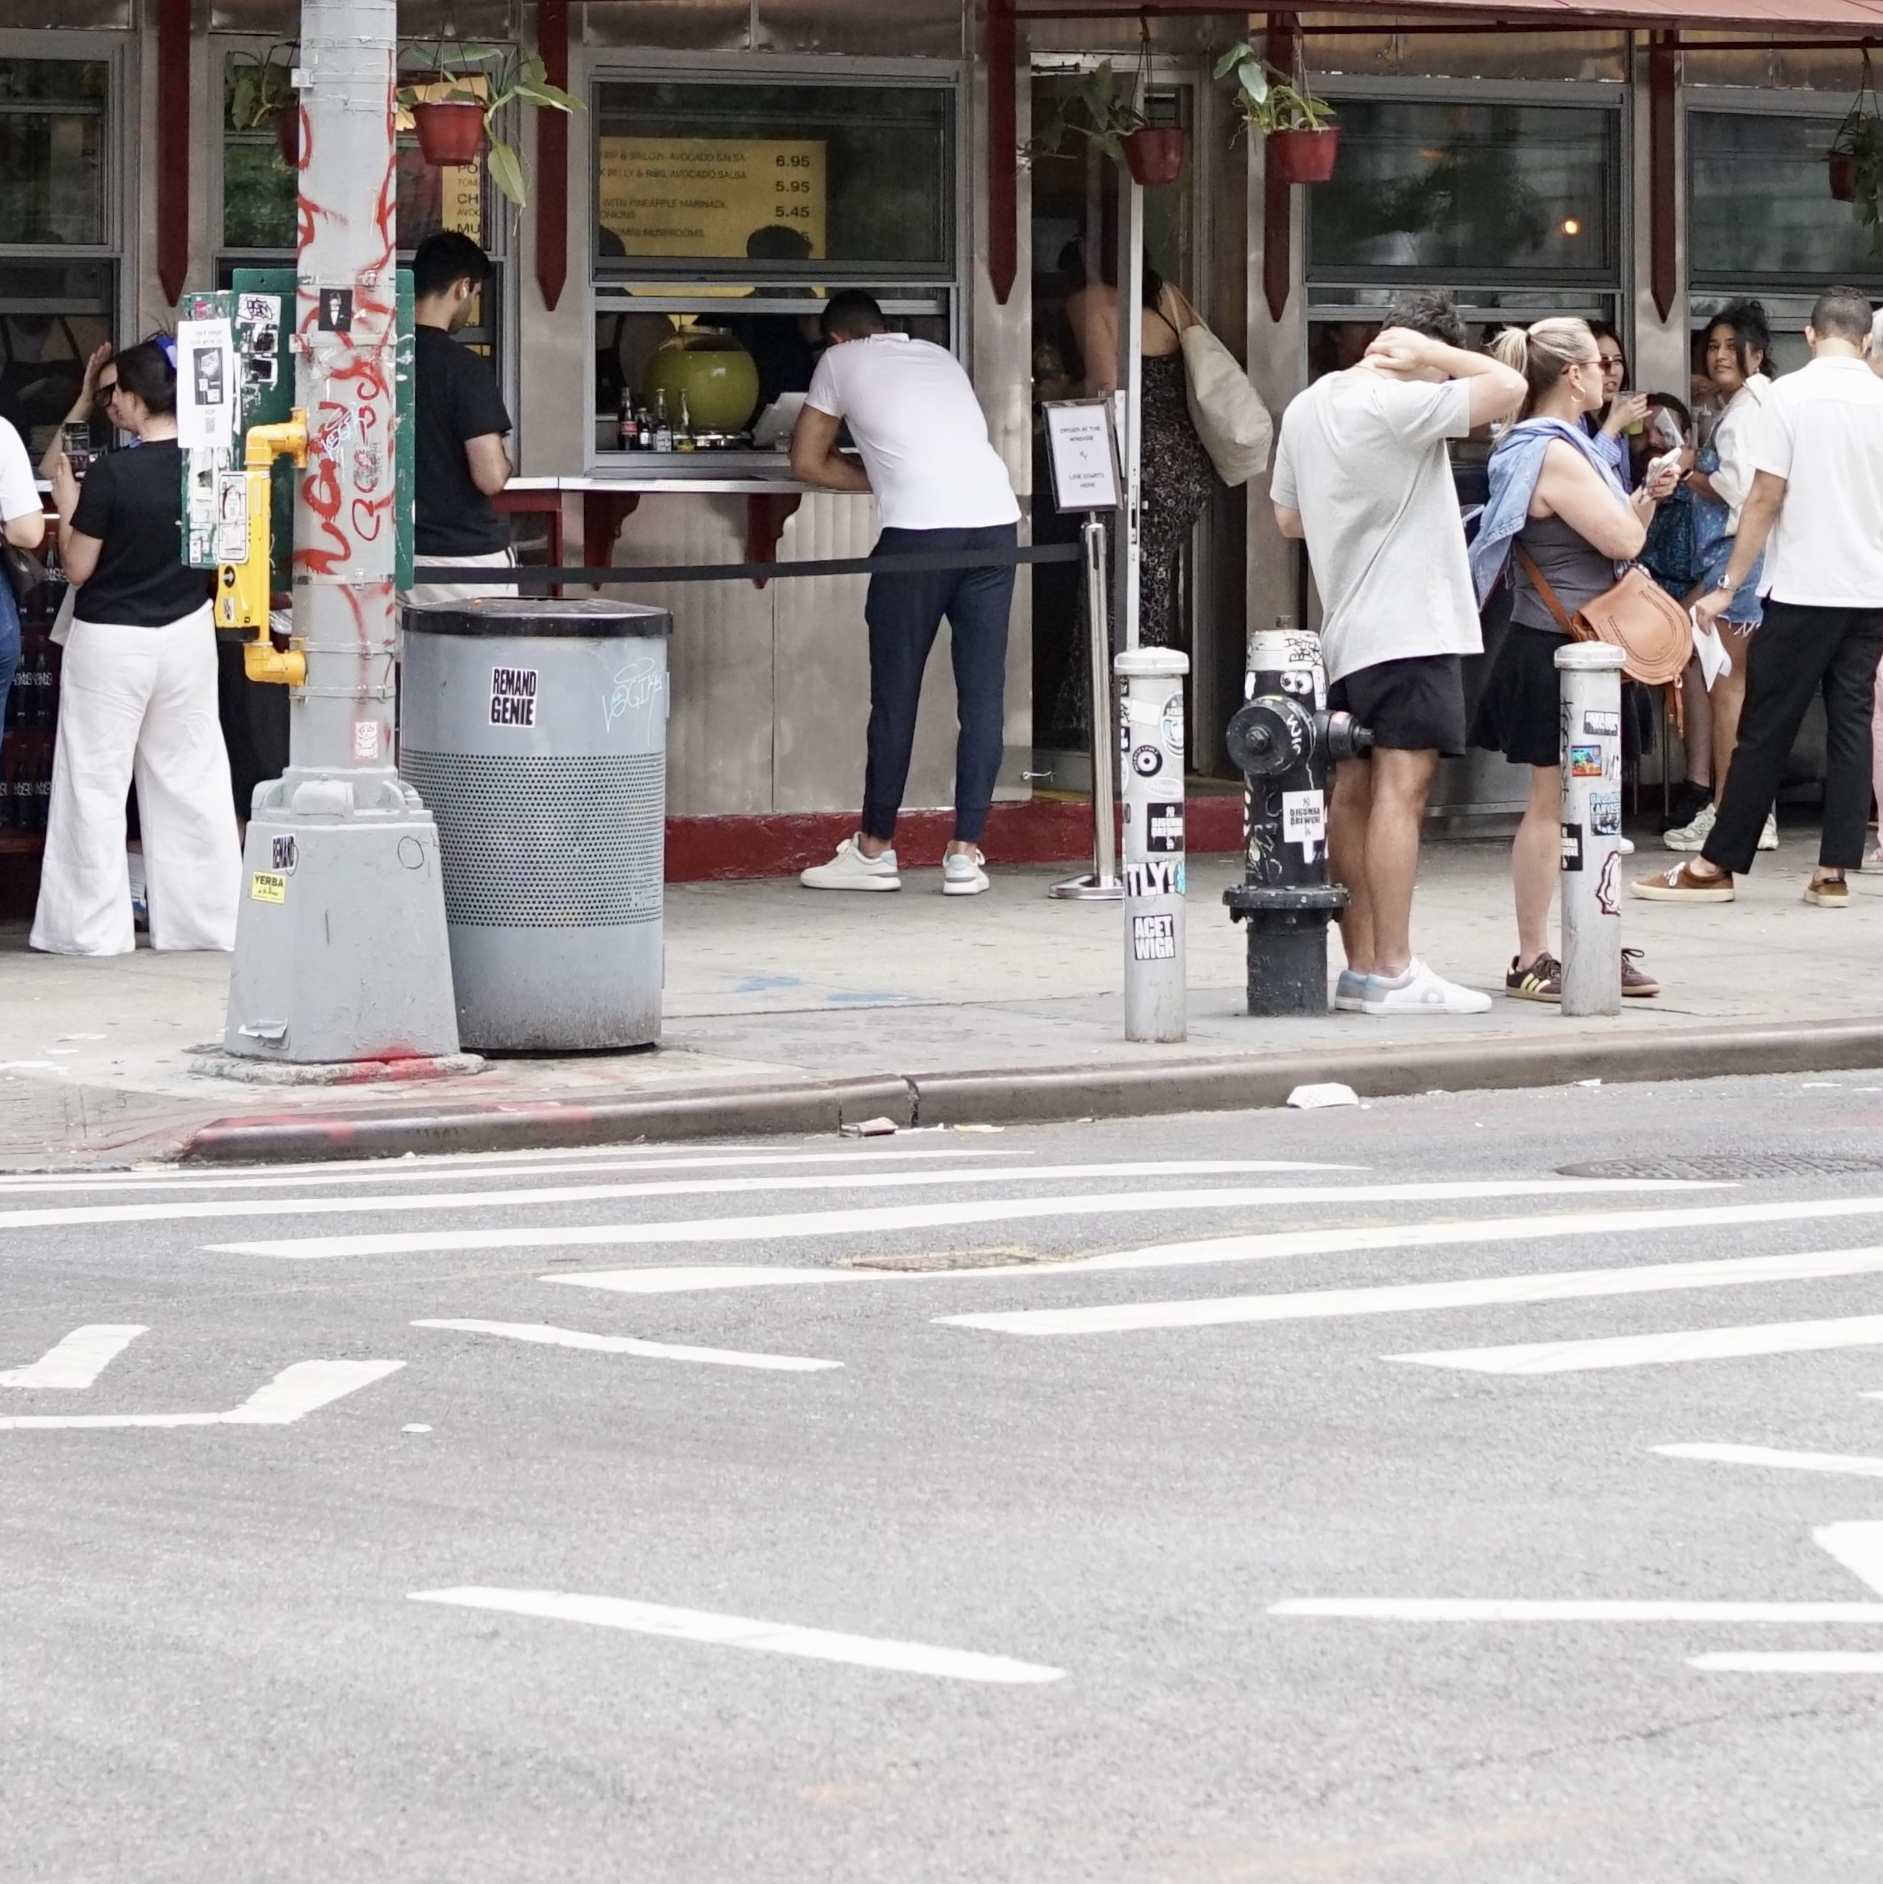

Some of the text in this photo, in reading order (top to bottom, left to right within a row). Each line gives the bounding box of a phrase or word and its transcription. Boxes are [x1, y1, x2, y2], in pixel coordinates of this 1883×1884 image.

[775, 155, 810, 168] 6.95
[775, 180, 810, 193] 5.95
[775, 205, 810, 218] 5.45
[492, 668, 537, 697] REMAND
[491, 696, 534, 725] GENIE
[1134, 916, 1173, 939] ACET
[1135, 936, 1175, 960] WIGR
